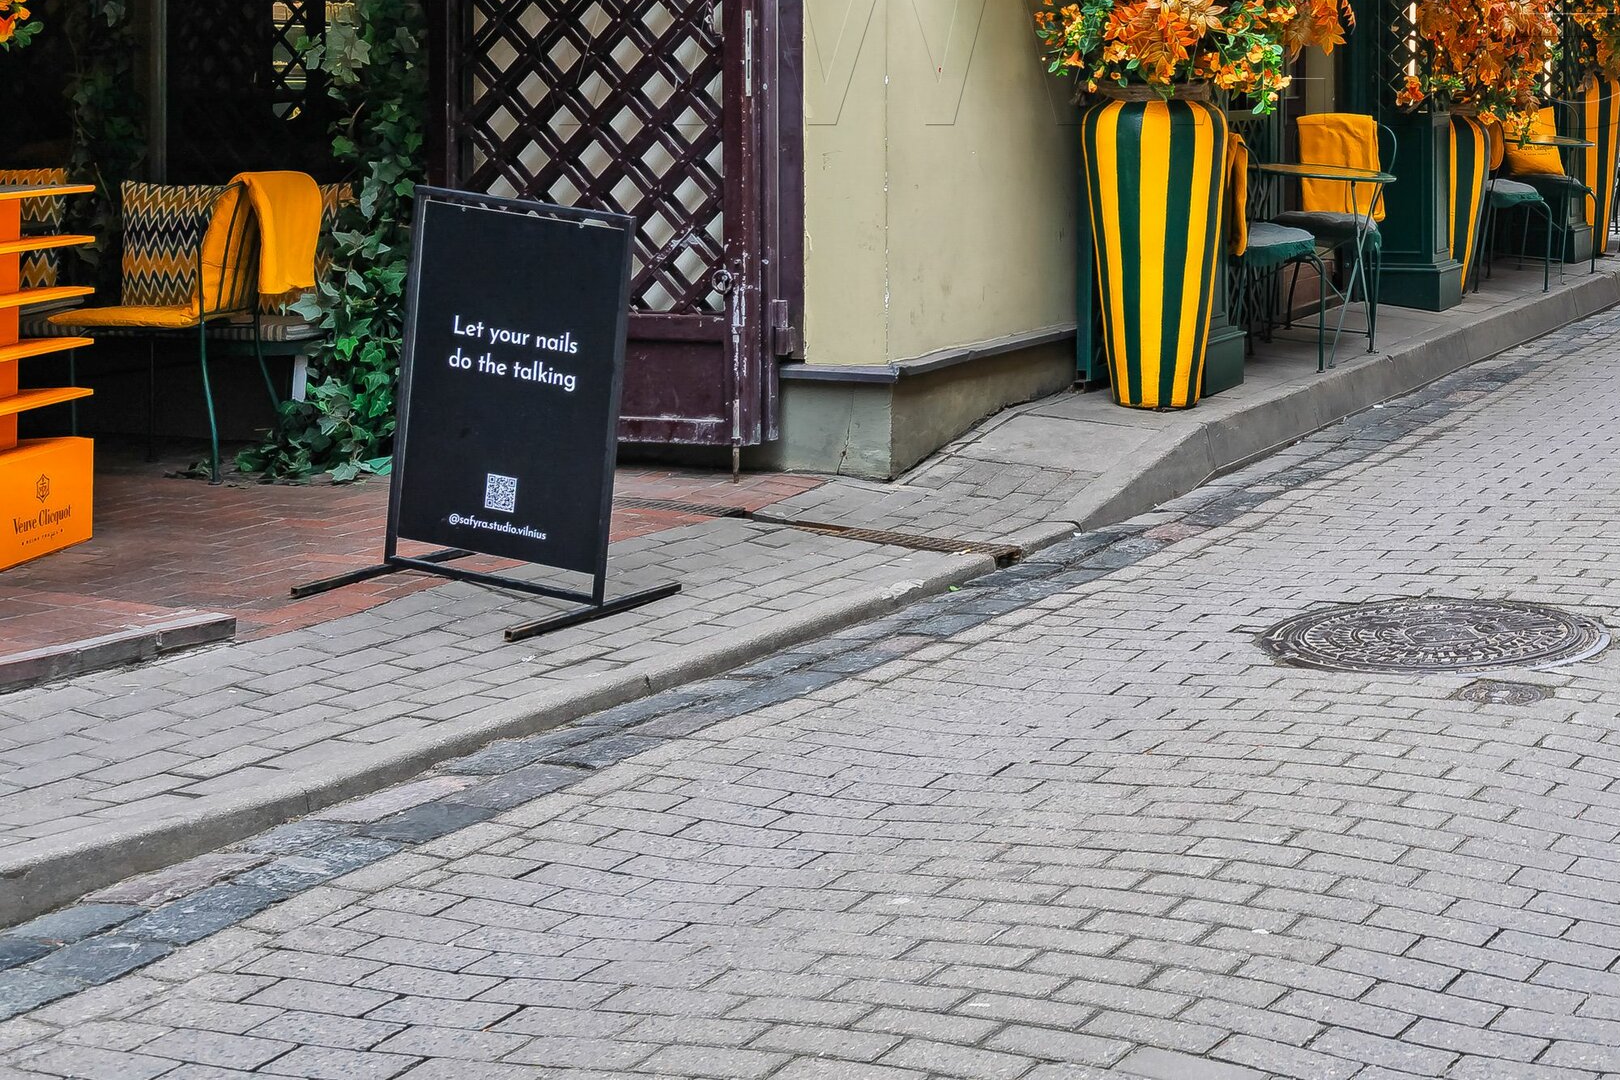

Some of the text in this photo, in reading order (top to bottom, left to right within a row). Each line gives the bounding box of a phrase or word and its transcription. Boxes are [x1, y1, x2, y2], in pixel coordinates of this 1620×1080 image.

[454, 315, 579, 354] Let your nails
[448, 348, 577, 392] do the talking
[13, 505, 71, 534] Veuve Clicquot
[448, 513, 548, 540] @safyra.studio.vilnius
